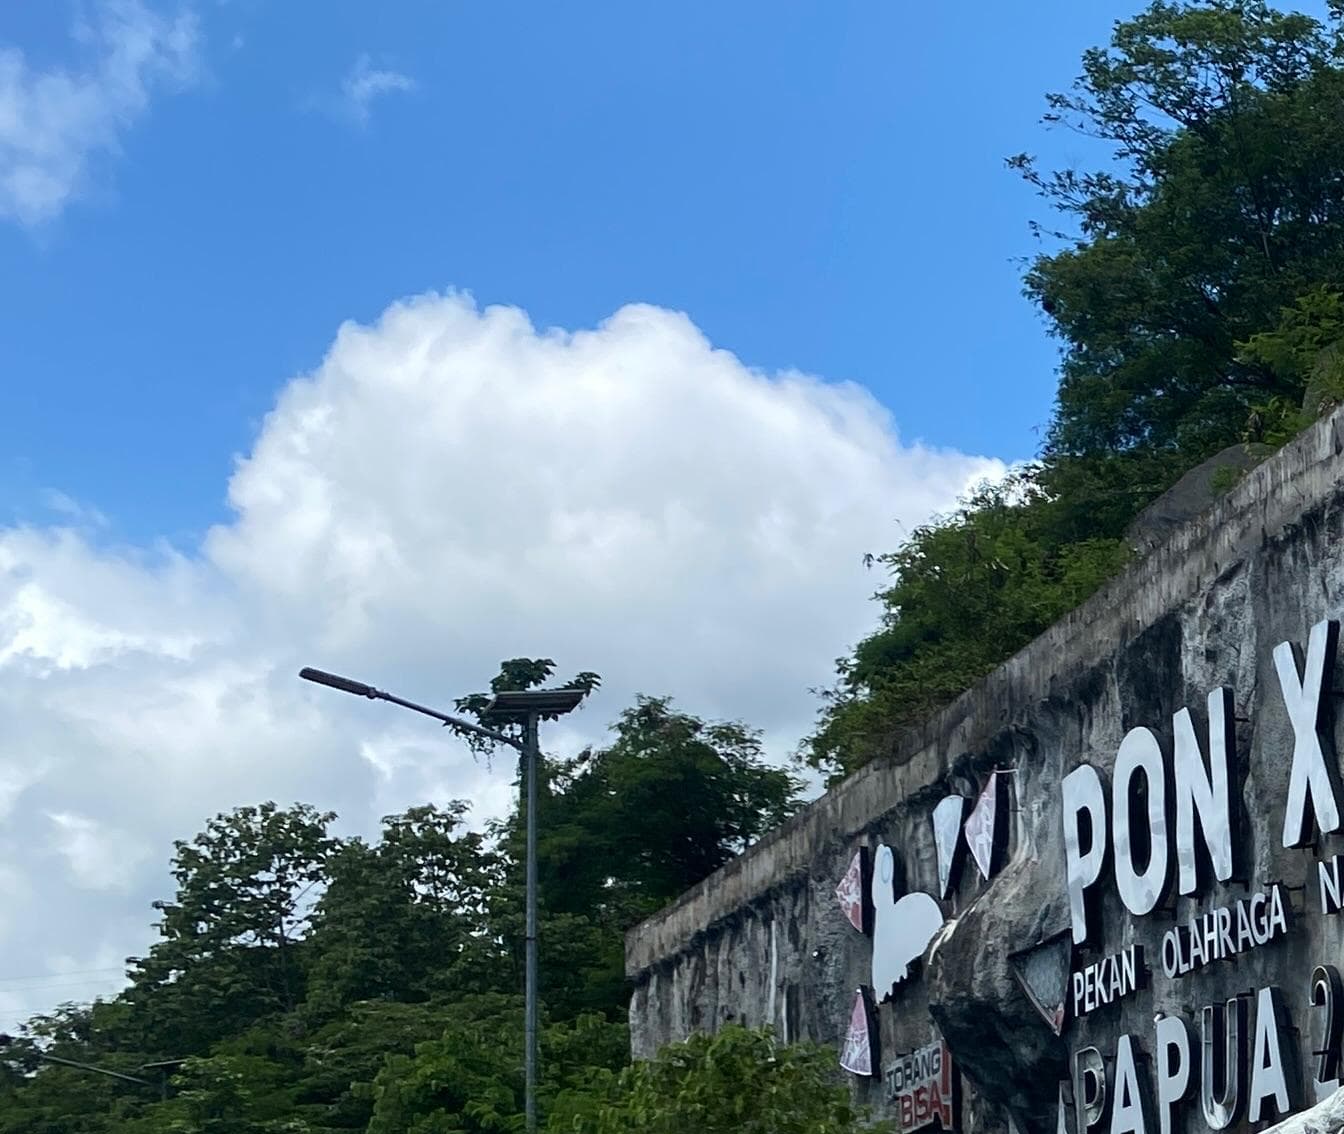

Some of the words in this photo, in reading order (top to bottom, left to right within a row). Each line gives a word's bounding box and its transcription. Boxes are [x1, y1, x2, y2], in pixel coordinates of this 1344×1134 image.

[1061, 686, 1232, 944] PON
[1073, 944, 1137, 1017] PEKAN
[1162, 885, 1288, 979] OLAHRAGA
[886, 1047, 942, 1097] TORANG
